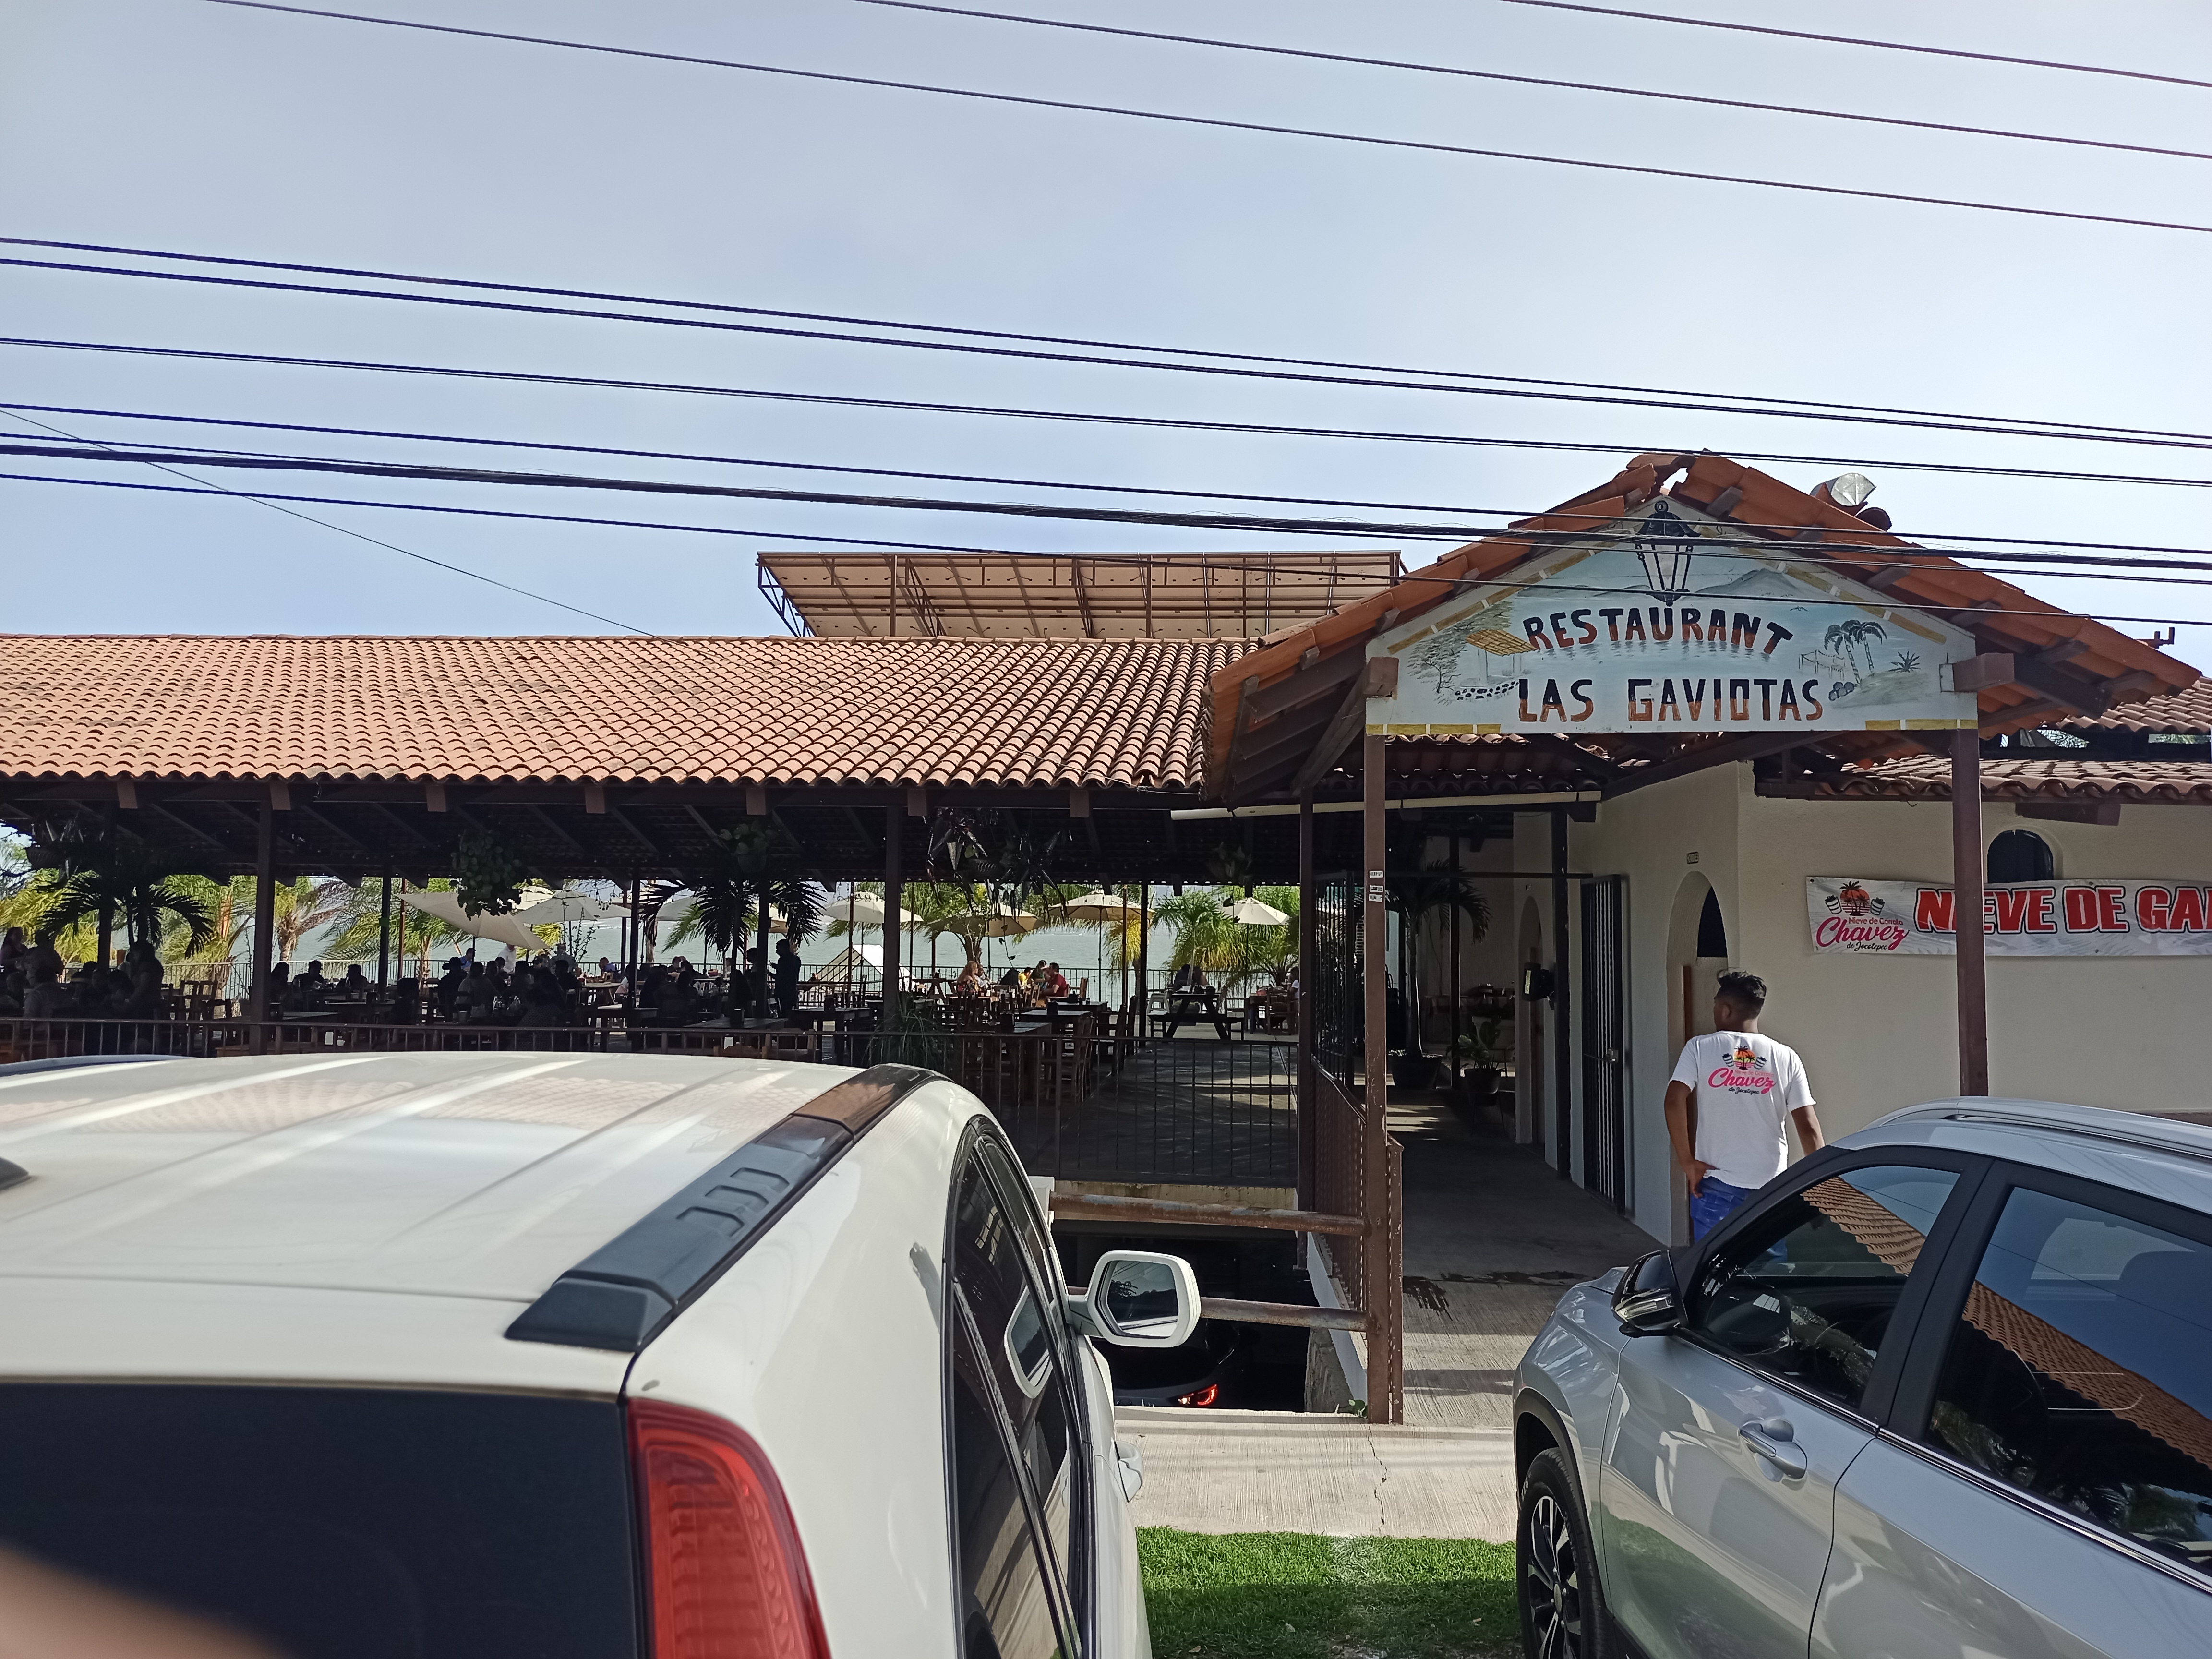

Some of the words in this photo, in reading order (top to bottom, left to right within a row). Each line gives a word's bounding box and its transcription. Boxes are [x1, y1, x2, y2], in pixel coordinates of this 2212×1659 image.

[1523, 606, 1793, 654] RESTAURANT
[1519, 678, 1593, 722] LAS
[1628, 678, 1824, 721] GAVIOTAS
[1914, 887, 2057, 934] NVE
[2062, 886, 2130, 933] DE
[2135, 886, 2212, 933] GA
[1816, 916, 1910, 950] Chavez
[1854, 941, 1887, 952] Jocotepec
[1708, 1067, 1777, 1094] Chavez
